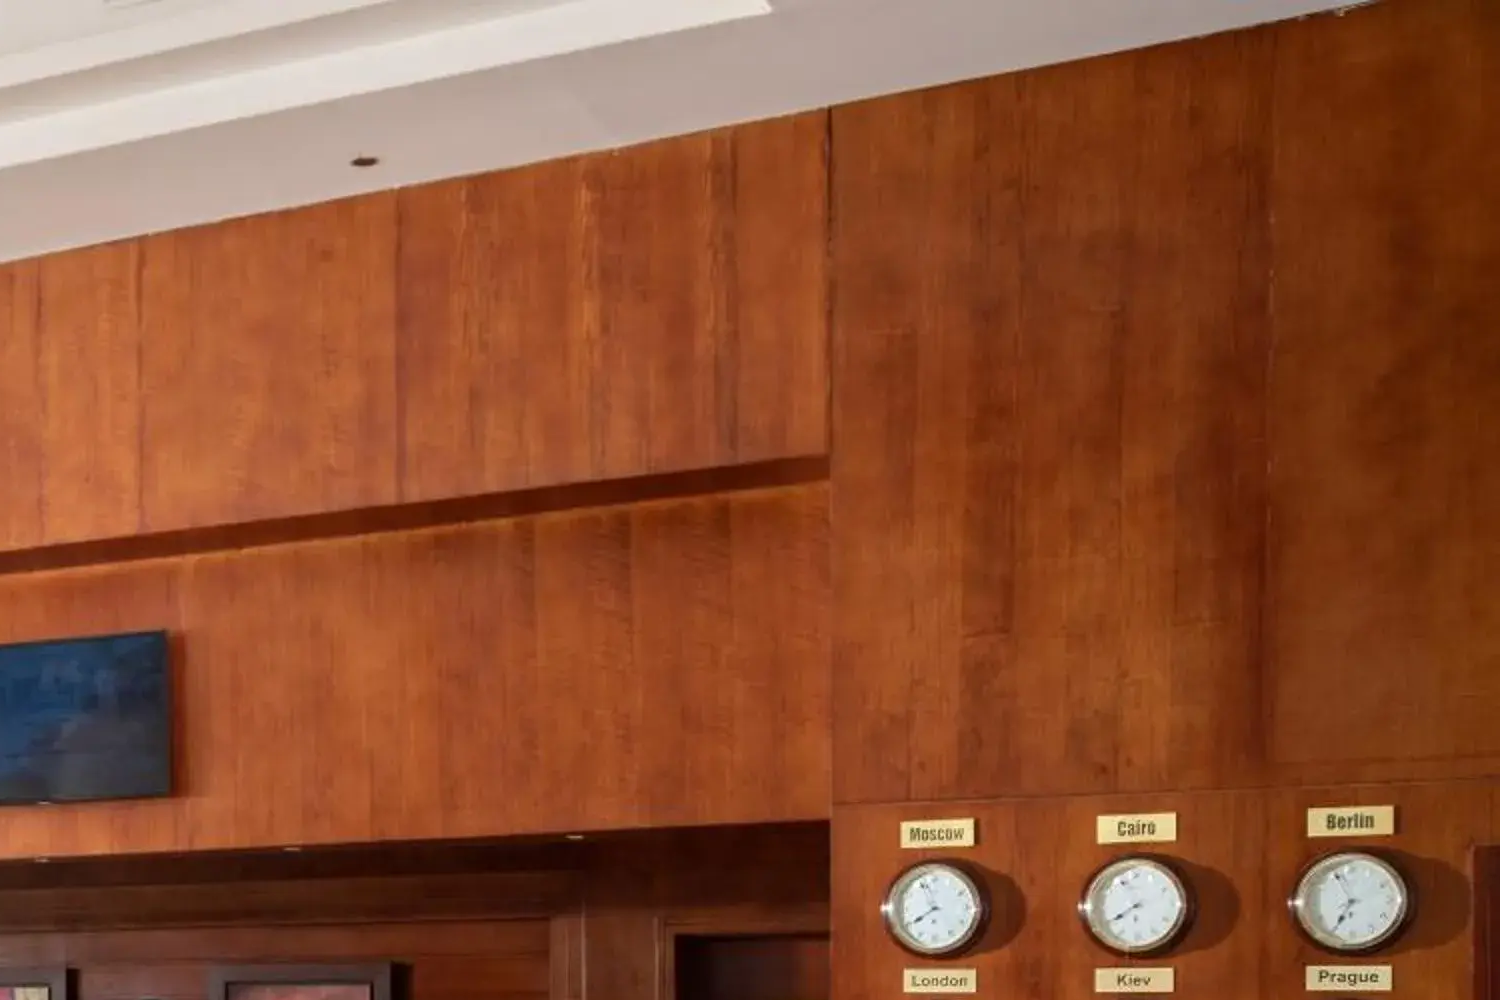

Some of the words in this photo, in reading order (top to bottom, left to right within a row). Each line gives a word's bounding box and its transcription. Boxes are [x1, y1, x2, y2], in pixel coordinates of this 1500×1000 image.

[1116, 819, 1156, 837] Cairo
[1326, 813, 1375, 830] Berlin
[909, 827, 965, 841] Moscow
[911, 975, 968, 987] London
[1116, 974, 1152, 987] Kiev
[1317, 970, 1379, 986] Prague
